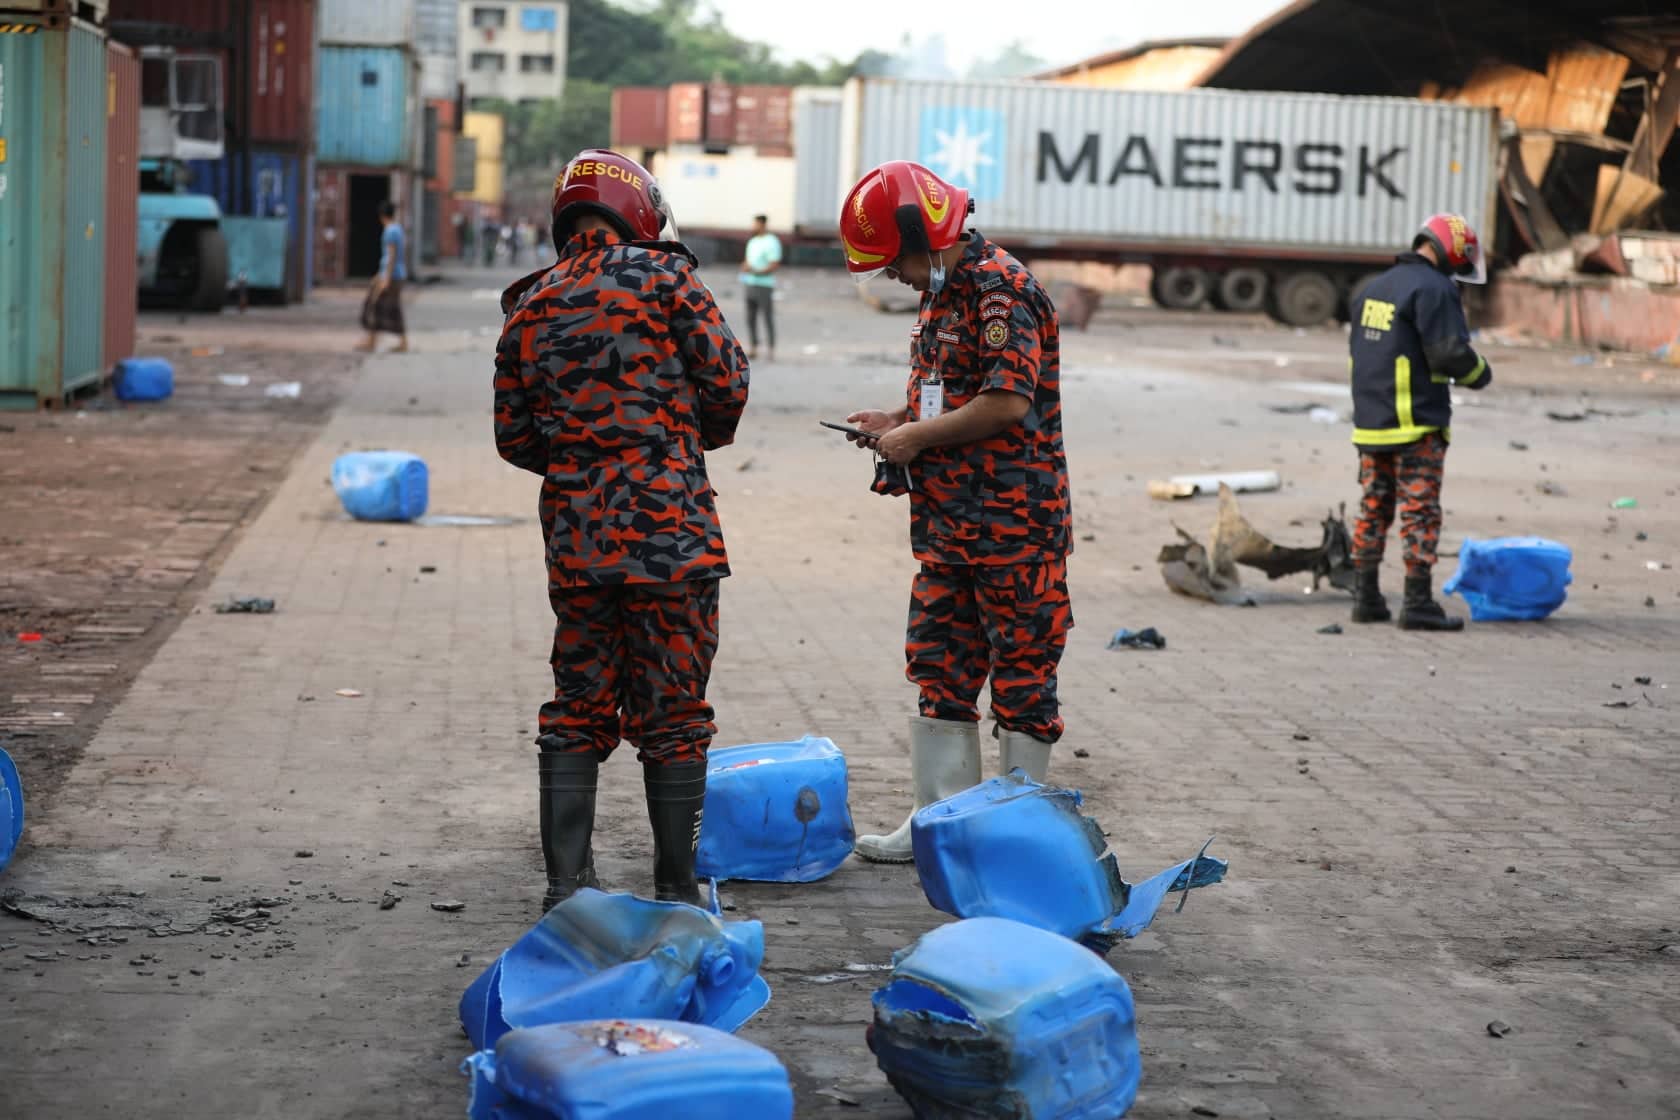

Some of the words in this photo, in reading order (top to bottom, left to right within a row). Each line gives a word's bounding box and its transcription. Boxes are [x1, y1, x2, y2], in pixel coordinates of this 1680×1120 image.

[570, 162, 644, 191] RESCUE
[1036, 131, 1409, 200] MAERSK
[924, 174, 942, 205] FIRE
[853, 192, 876, 238] RESCUE
[983, 308, 1009, 318] RESCUE
[1361, 298, 1396, 331] FIRE
[691, 808, 704, 853] FIRE
